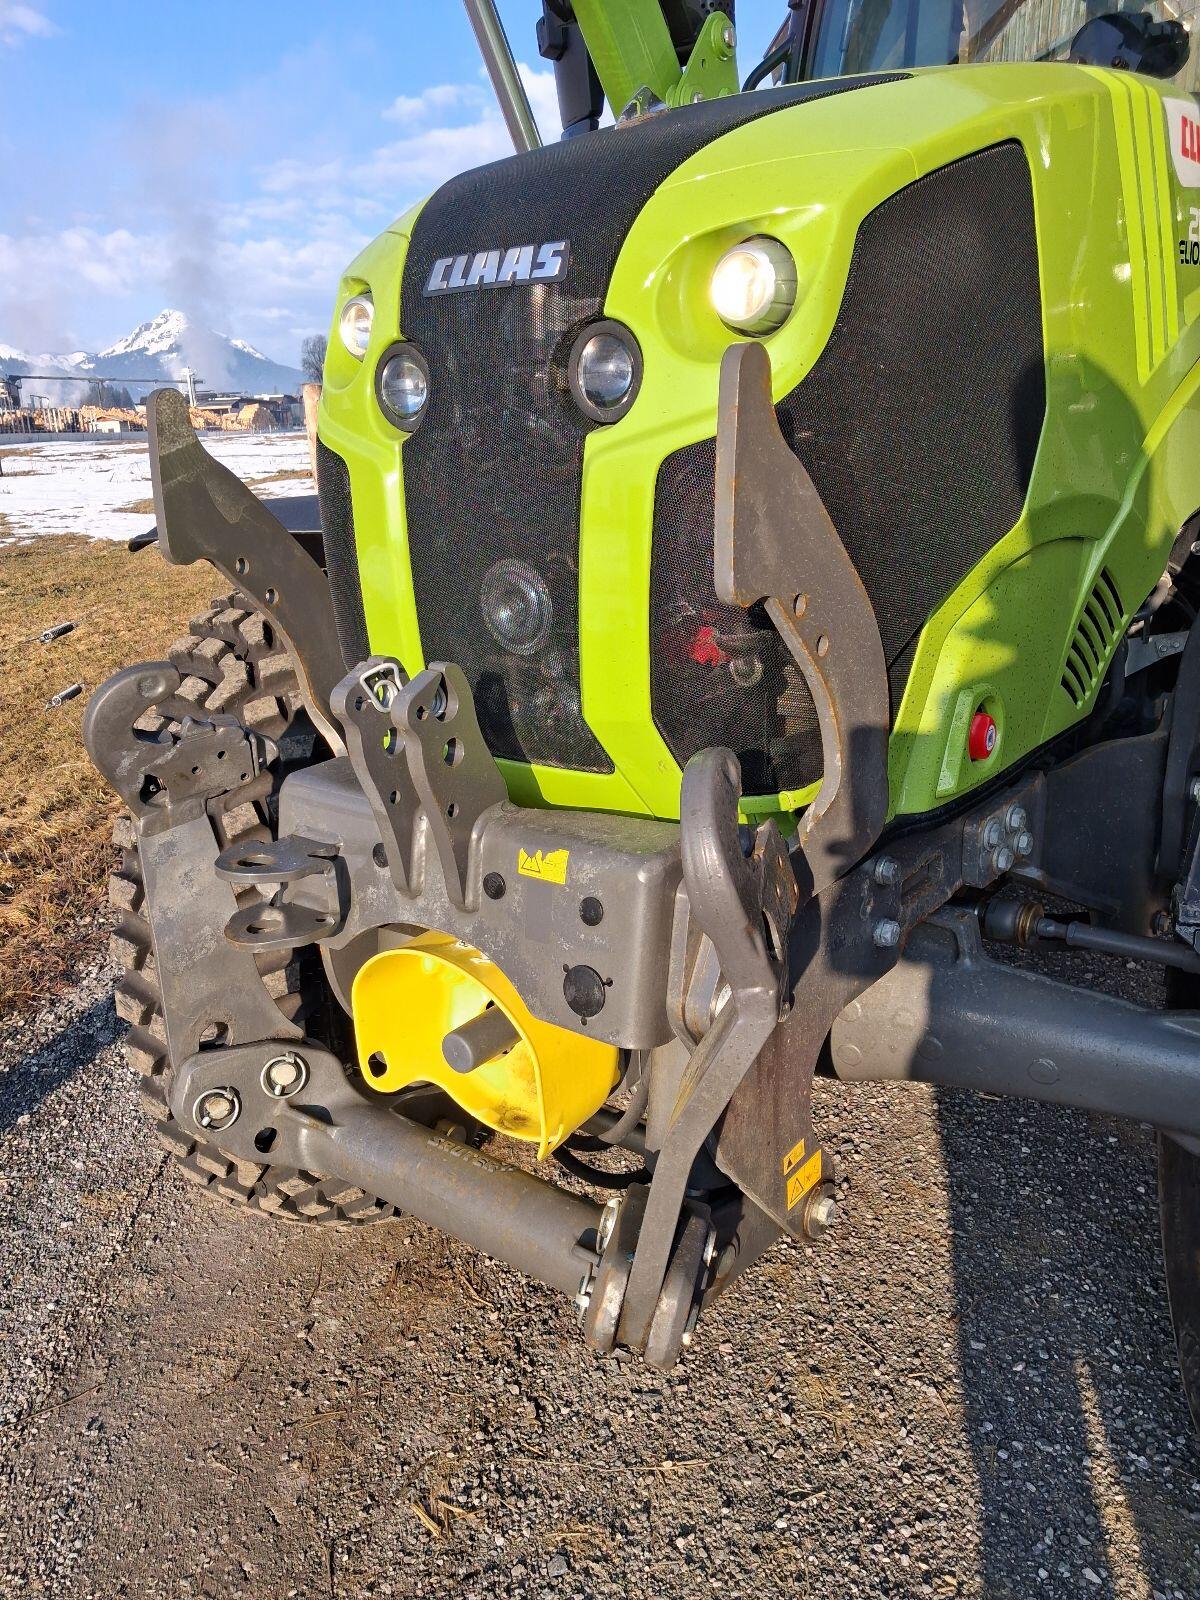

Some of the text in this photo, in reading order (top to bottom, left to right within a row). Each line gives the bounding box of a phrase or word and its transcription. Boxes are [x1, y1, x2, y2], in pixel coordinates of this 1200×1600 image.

[1189, 206, 1200, 241] 2
[427, 241, 566, 291] CLAAS
[1179, 239, 1200, 266] ELIO
